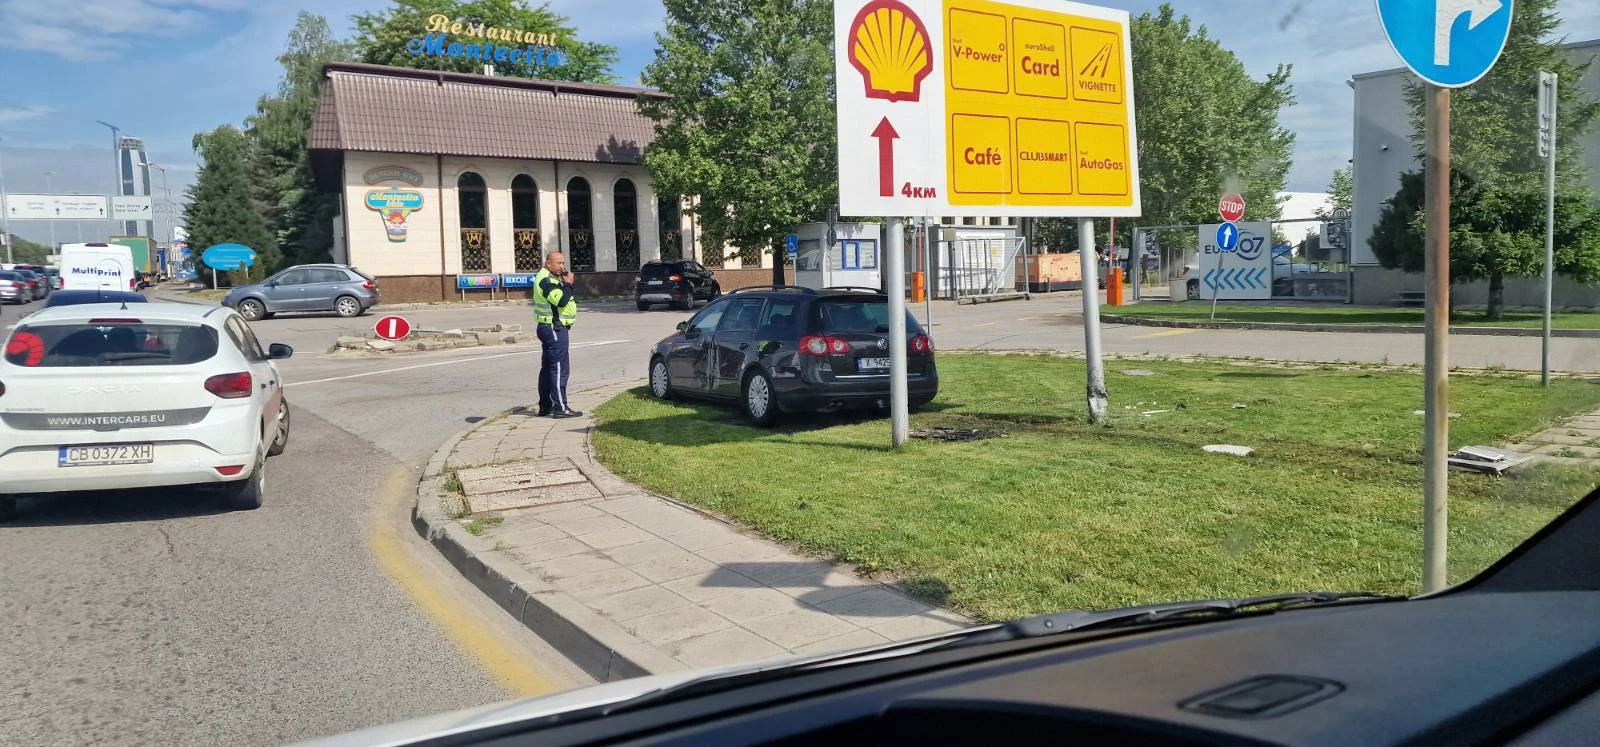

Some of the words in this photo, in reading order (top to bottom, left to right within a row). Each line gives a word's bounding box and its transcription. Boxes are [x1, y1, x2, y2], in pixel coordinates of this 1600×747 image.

[425, 13, 557, 46] Restaurant
[406, 31, 561, 68] Montecito
[953, 45, 1002, 63] V-Power
[1021, 55, 1060, 77] Card
[1078, 79, 1117, 93] VIGNETTE
[964, 147, 1002, 166] Café
[1019, 151, 1068, 162] CLUBSMART
[1079, 158, 1124, 170] AutoGas
[1221, 200, 1243, 213] STOP
[1205, 244, 1238, 254] EU
[505, 276, 527, 284] ВХОД
[47, 414, 165, 425] WWW.INTERCARS.EU
[70, 447, 88, 461] CB
[92, 446, 127, 460] 0372
[131, 445, 150, 459] XH
